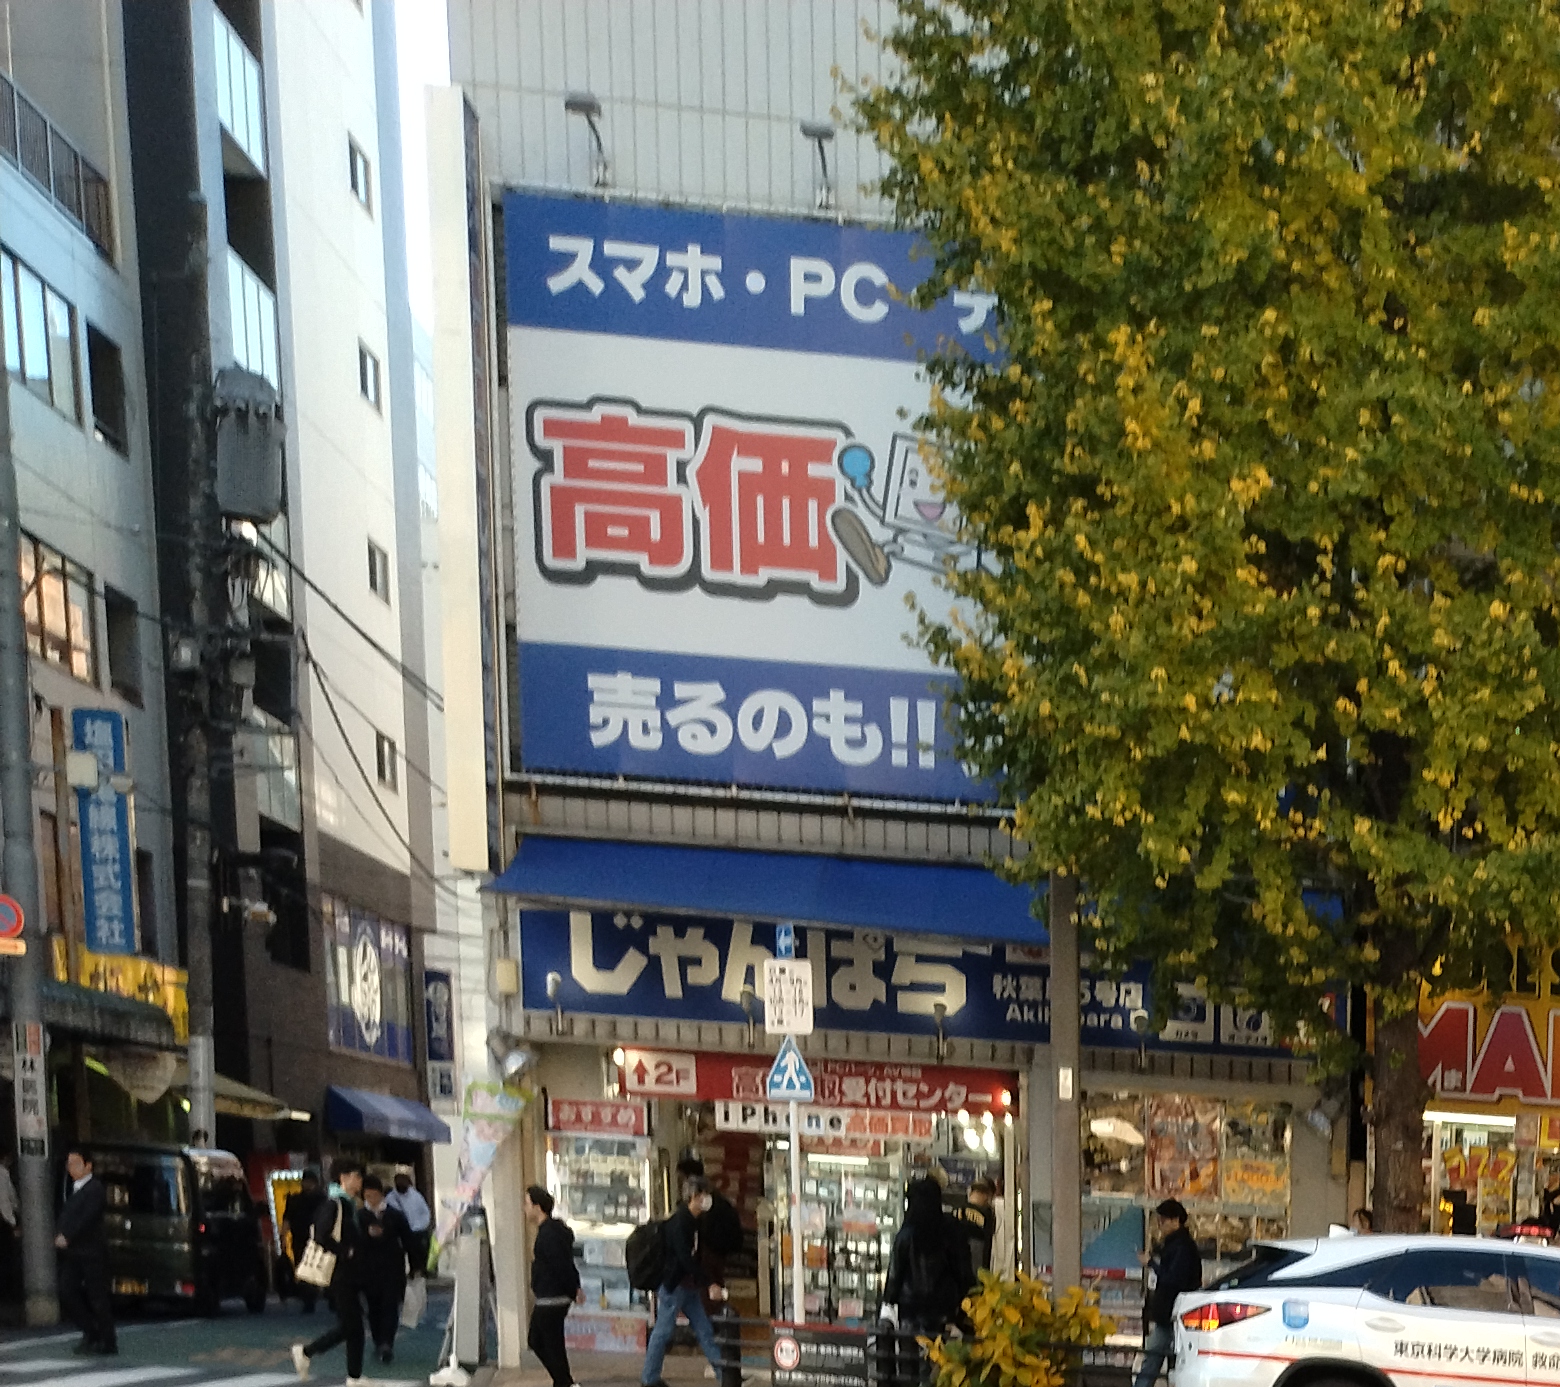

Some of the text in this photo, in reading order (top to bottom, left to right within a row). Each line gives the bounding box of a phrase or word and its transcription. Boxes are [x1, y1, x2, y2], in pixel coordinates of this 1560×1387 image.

[992, 973, 1143, 1010] 秋葉5号店
[654, 1060, 691, 1086] 2F
[1394, 1339, 1524, 1368] 東京科学大学病院
